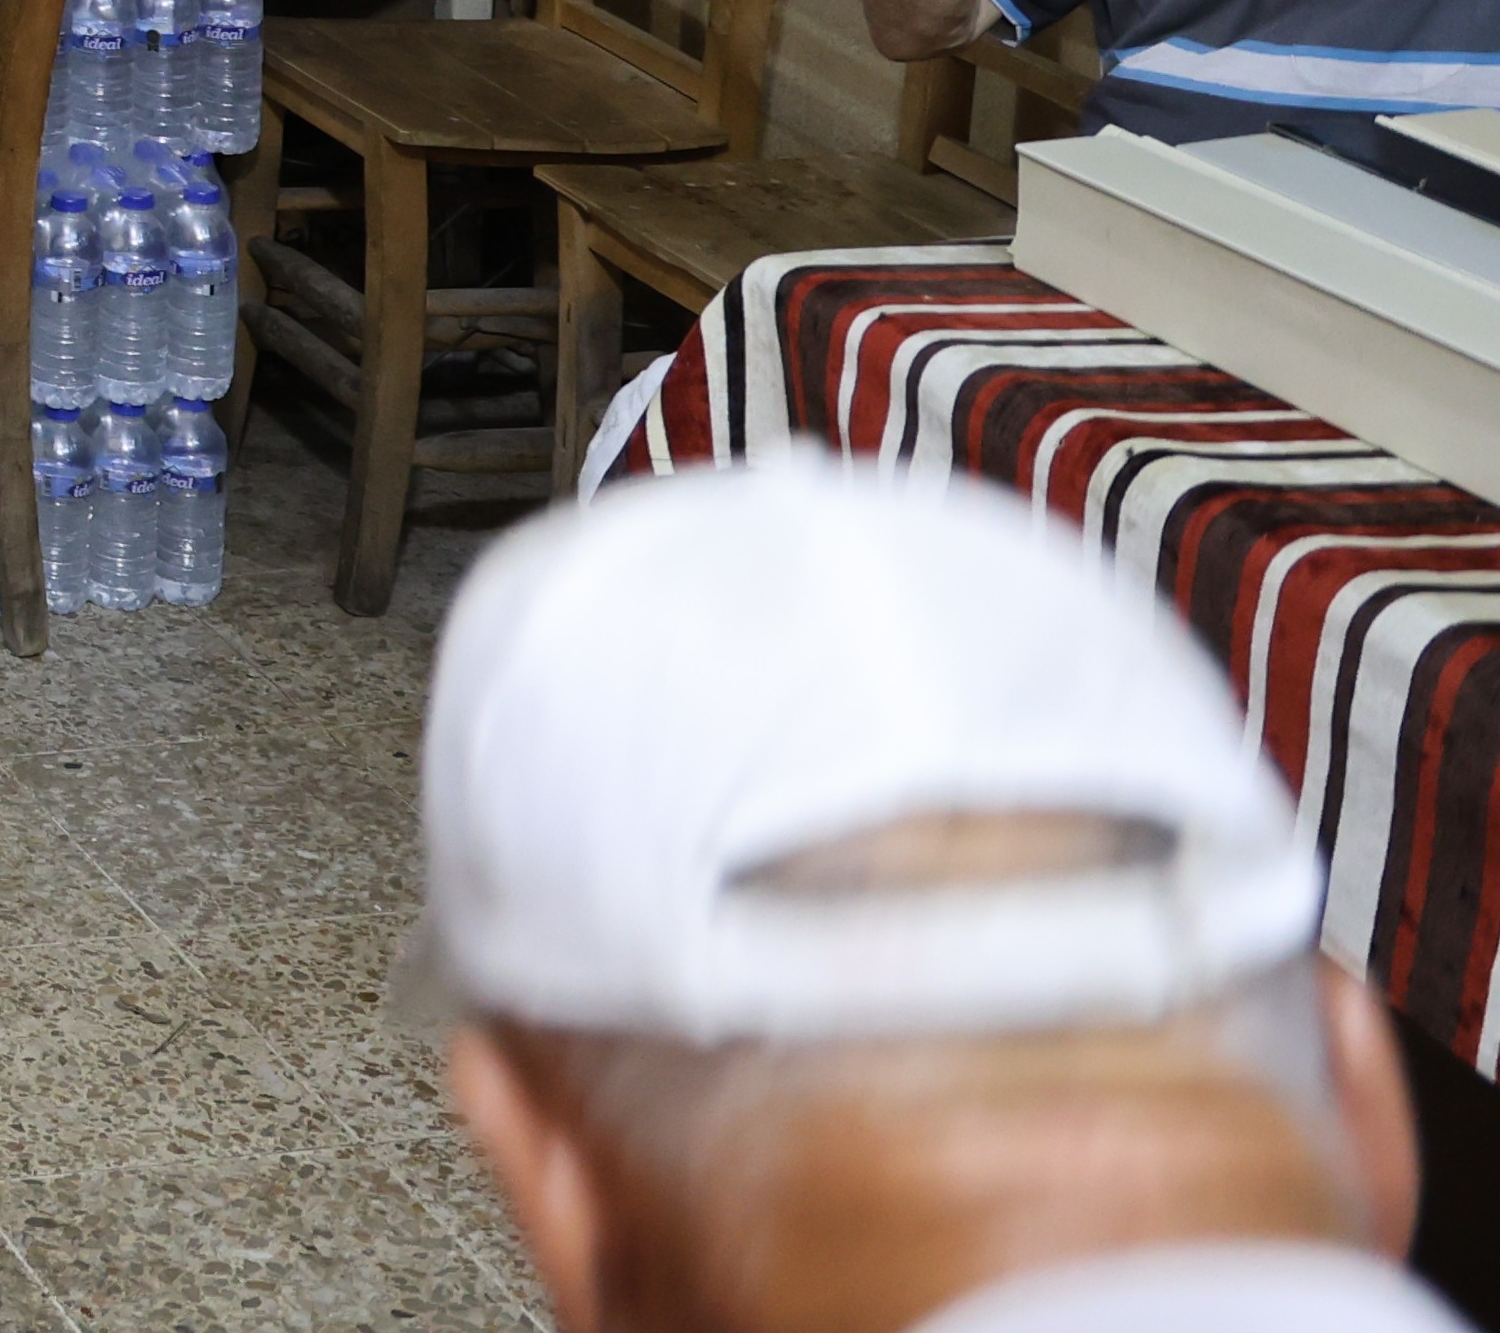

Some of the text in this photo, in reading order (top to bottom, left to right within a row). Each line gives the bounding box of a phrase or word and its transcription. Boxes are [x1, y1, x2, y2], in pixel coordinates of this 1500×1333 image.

[206, 26, 245, 41] ideal
[83, 36, 122, 51] ideal
[126, 274, 165, 288] ideal
[131, 482, 157, 495] ide
